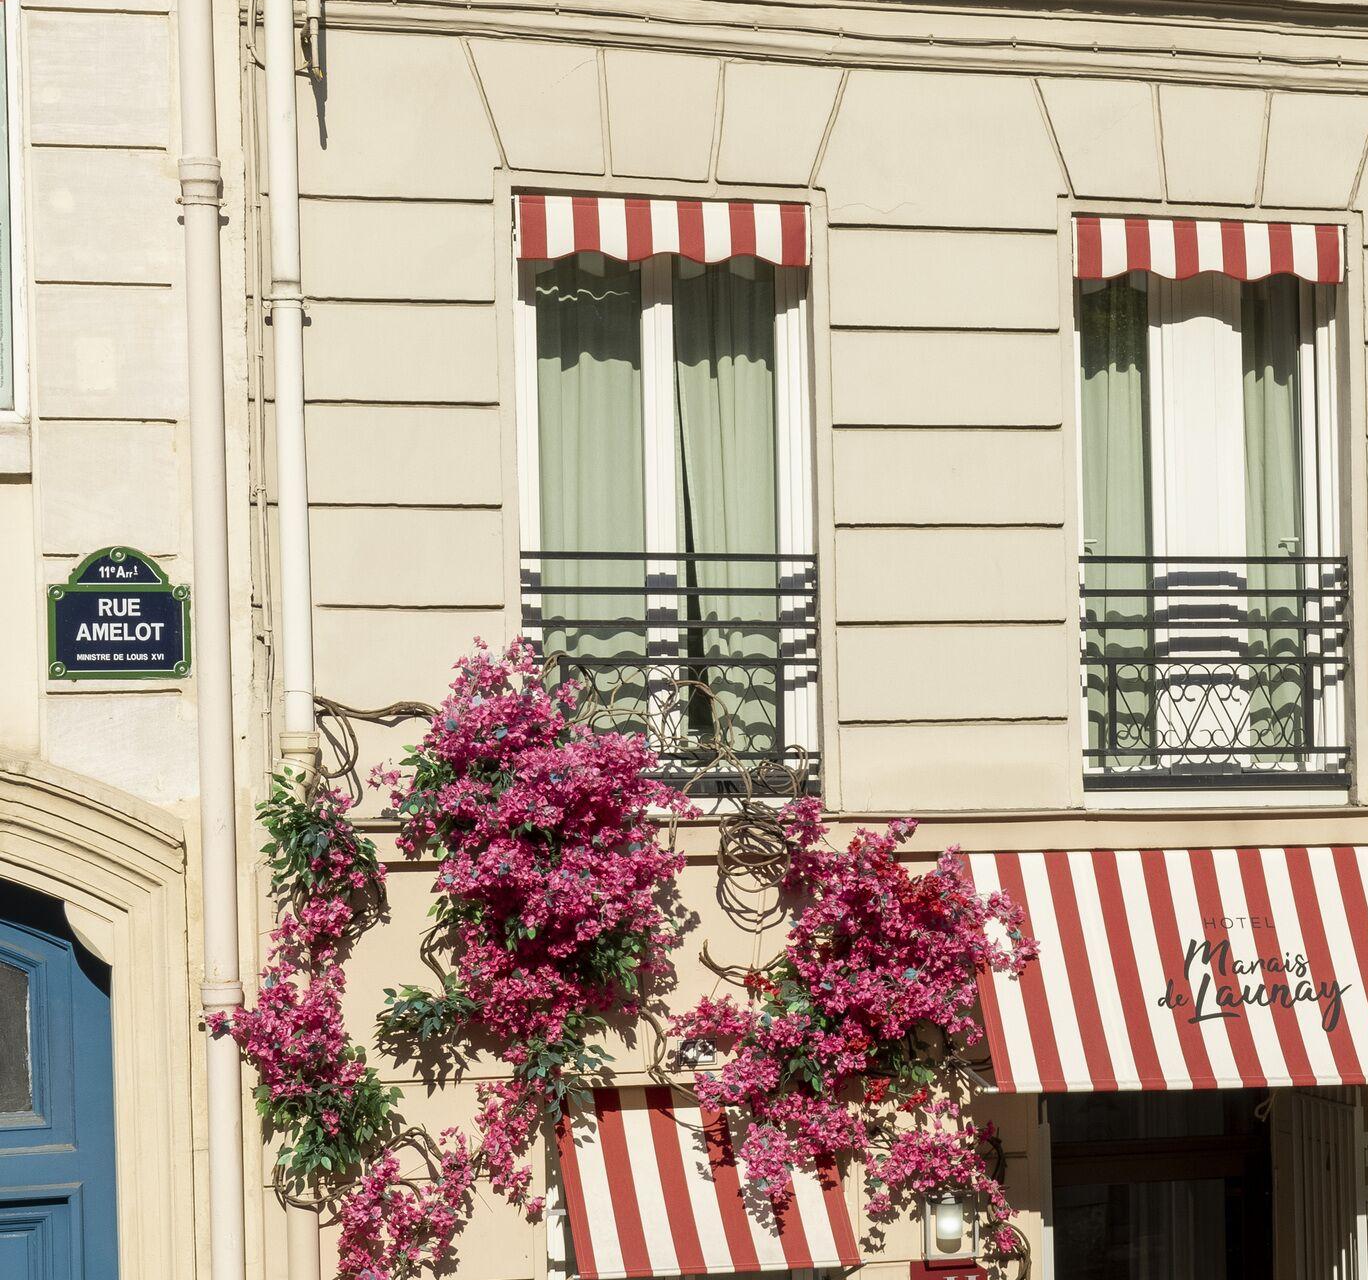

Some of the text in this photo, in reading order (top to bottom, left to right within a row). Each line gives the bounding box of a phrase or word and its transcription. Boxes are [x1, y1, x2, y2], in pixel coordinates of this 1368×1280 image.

[98, 598, 141, 616] RUE
[76, 622, 164, 641] AMELOT
[76, 653, 165, 661] MINISTRE DE LOUIS XVI
[1204, 917, 1276, 929] HOTEL
[1184, 938, 1310, 981] Marais
[1157, 973, 1353, 1033] de Launay
